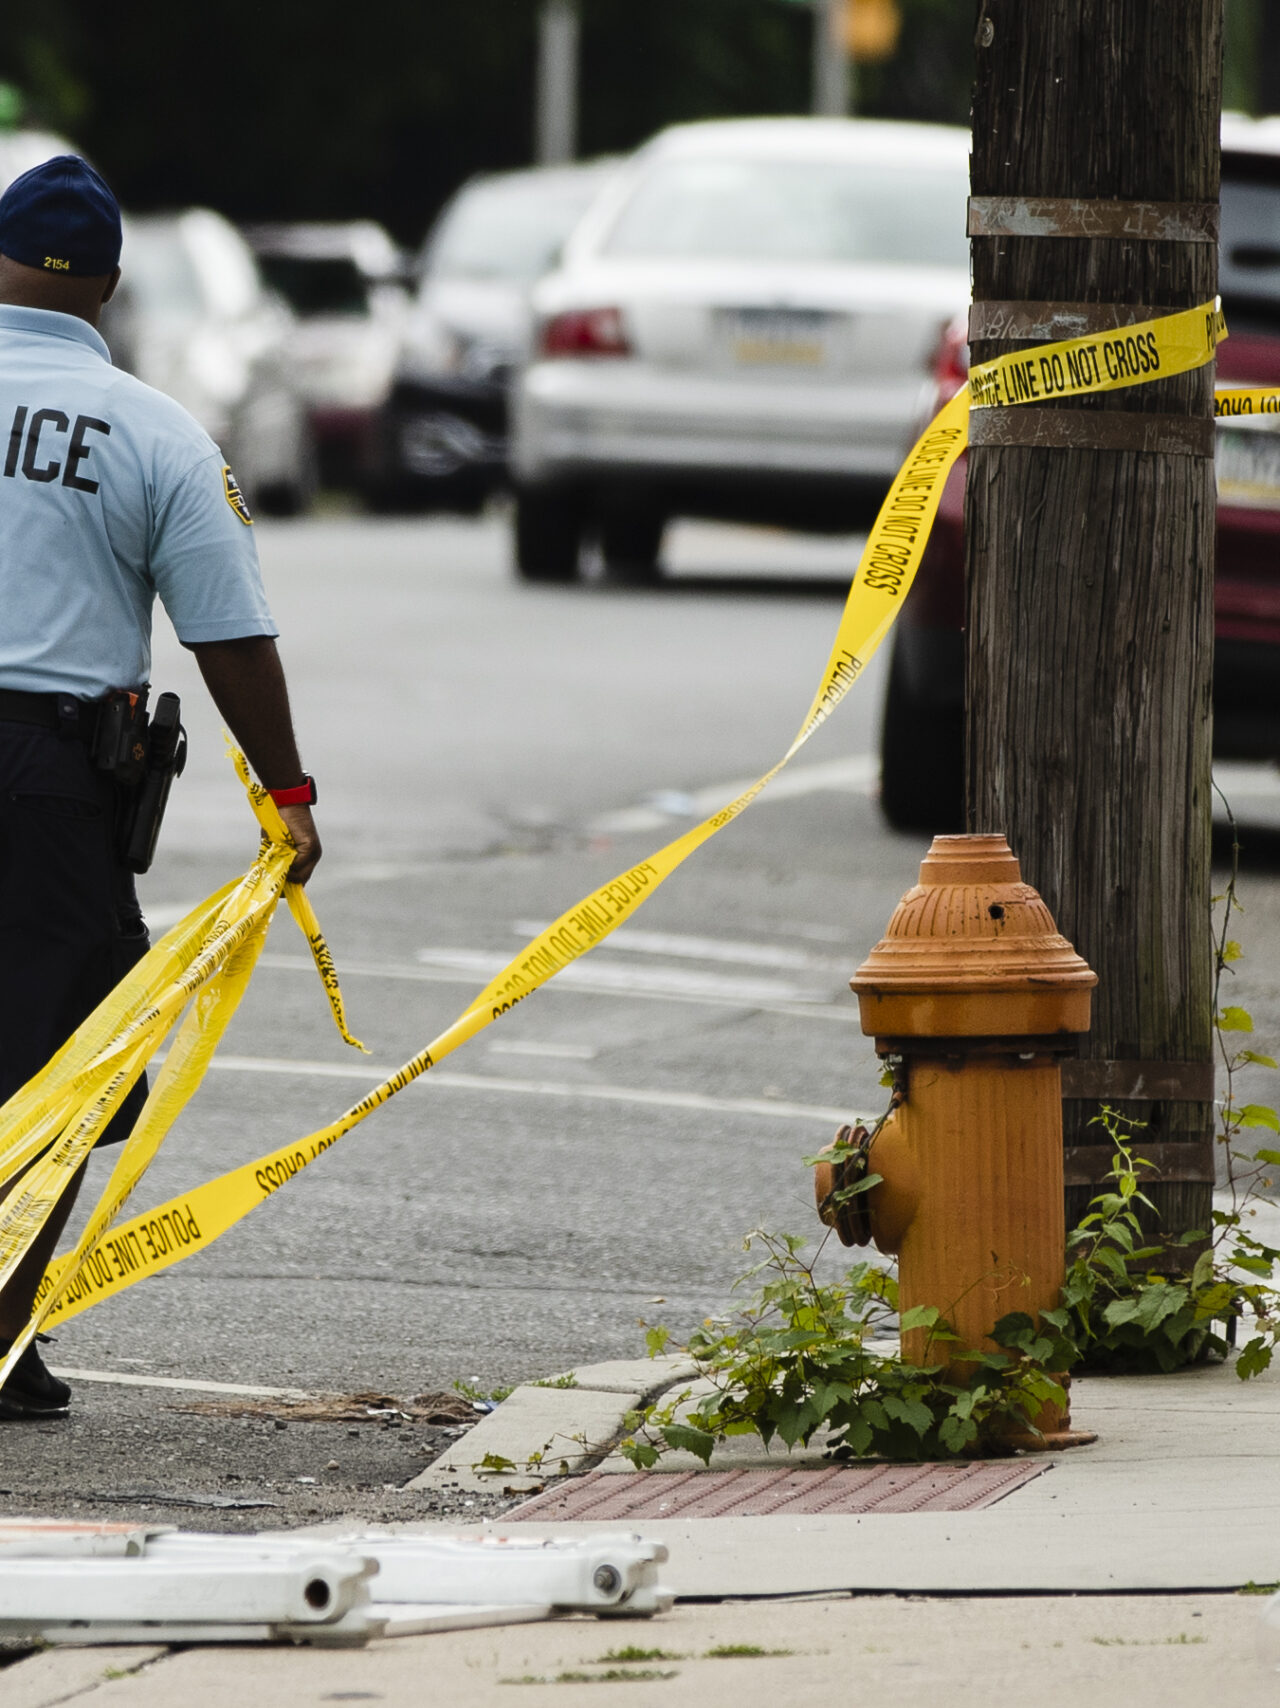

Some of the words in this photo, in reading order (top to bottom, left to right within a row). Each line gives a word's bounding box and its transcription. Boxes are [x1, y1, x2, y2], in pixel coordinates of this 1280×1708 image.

[43, 256, 70, 270] 2154
[1004, 361, 1040, 404] LINE
[1039, 355, 1065, 393] DO
[1066, 346, 1102, 389] NOT
[1104, 332, 1161, 380] CROSS
[912, 429, 962, 466] POLICE
[899, 466, 941, 492] LINE
[890, 495, 929, 512] DO
[880, 515, 922, 544] NOT
[864, 542, 912, 596] CROSS
[140, 1204, 201, 1260] POLICE
[87, 1247, 114, 1289] DO
[106, 1230, 148, 1278] LINE
